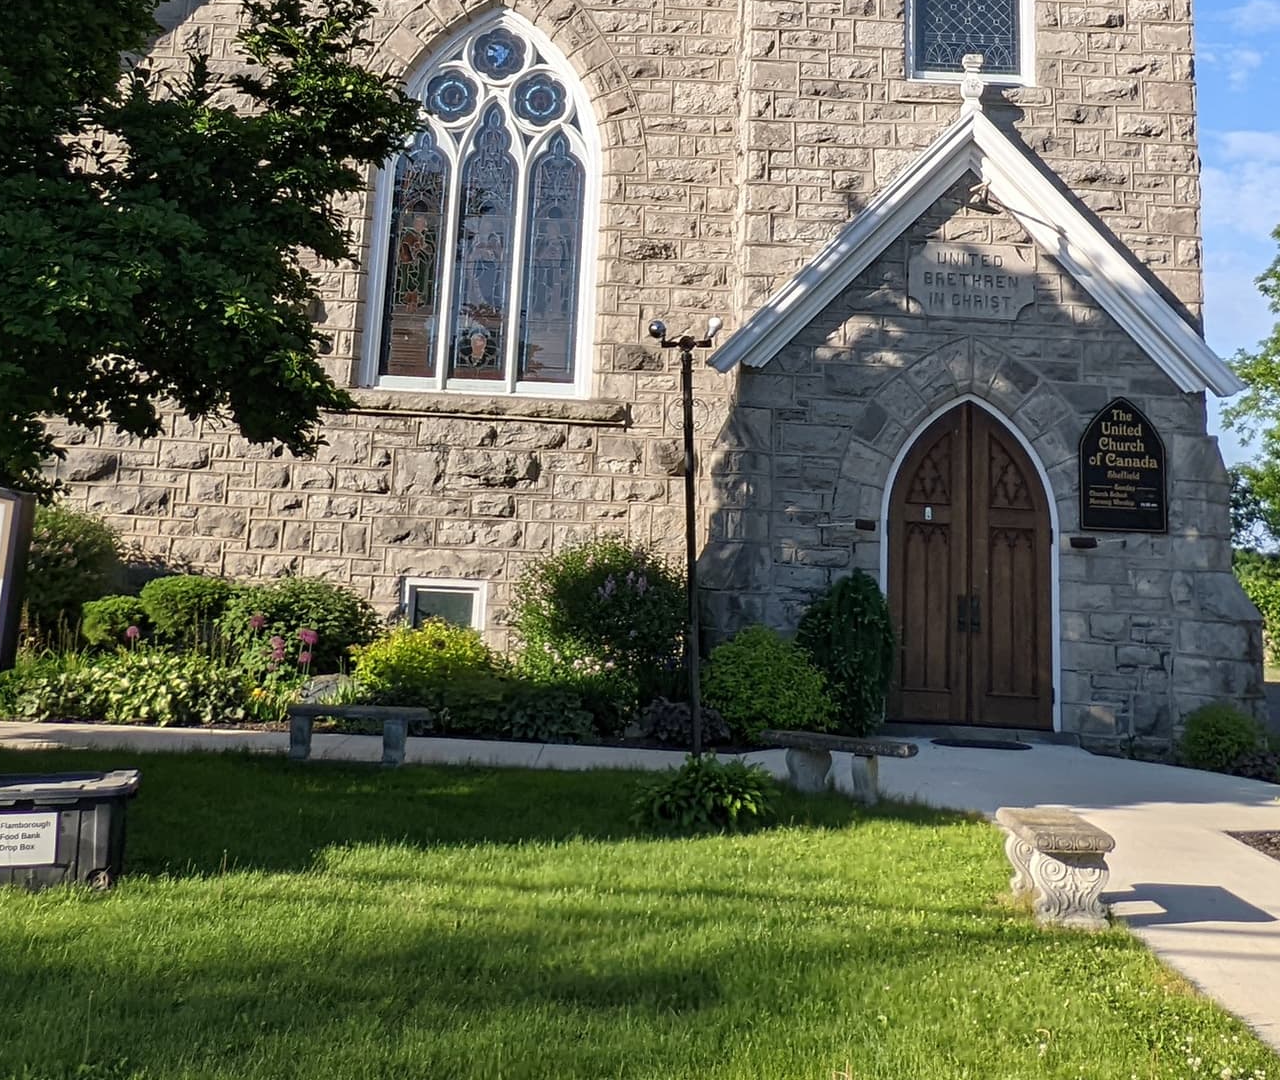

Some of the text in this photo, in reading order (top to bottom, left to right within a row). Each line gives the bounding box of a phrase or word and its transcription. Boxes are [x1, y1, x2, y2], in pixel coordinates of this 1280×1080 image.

[937, 252, 1003, 268] UNITED
[924, 272, 1018, 288] BRETHREN
[929, 292, 944, 307] IN
[1111, 409, 1133, 421] The
[1101, 421, 1142, 436] United
[1098, 437, 1145, 452] Church
[1089, 452, 1158, 469] of Canada
[0, 843, 35, 852] Drop Box
